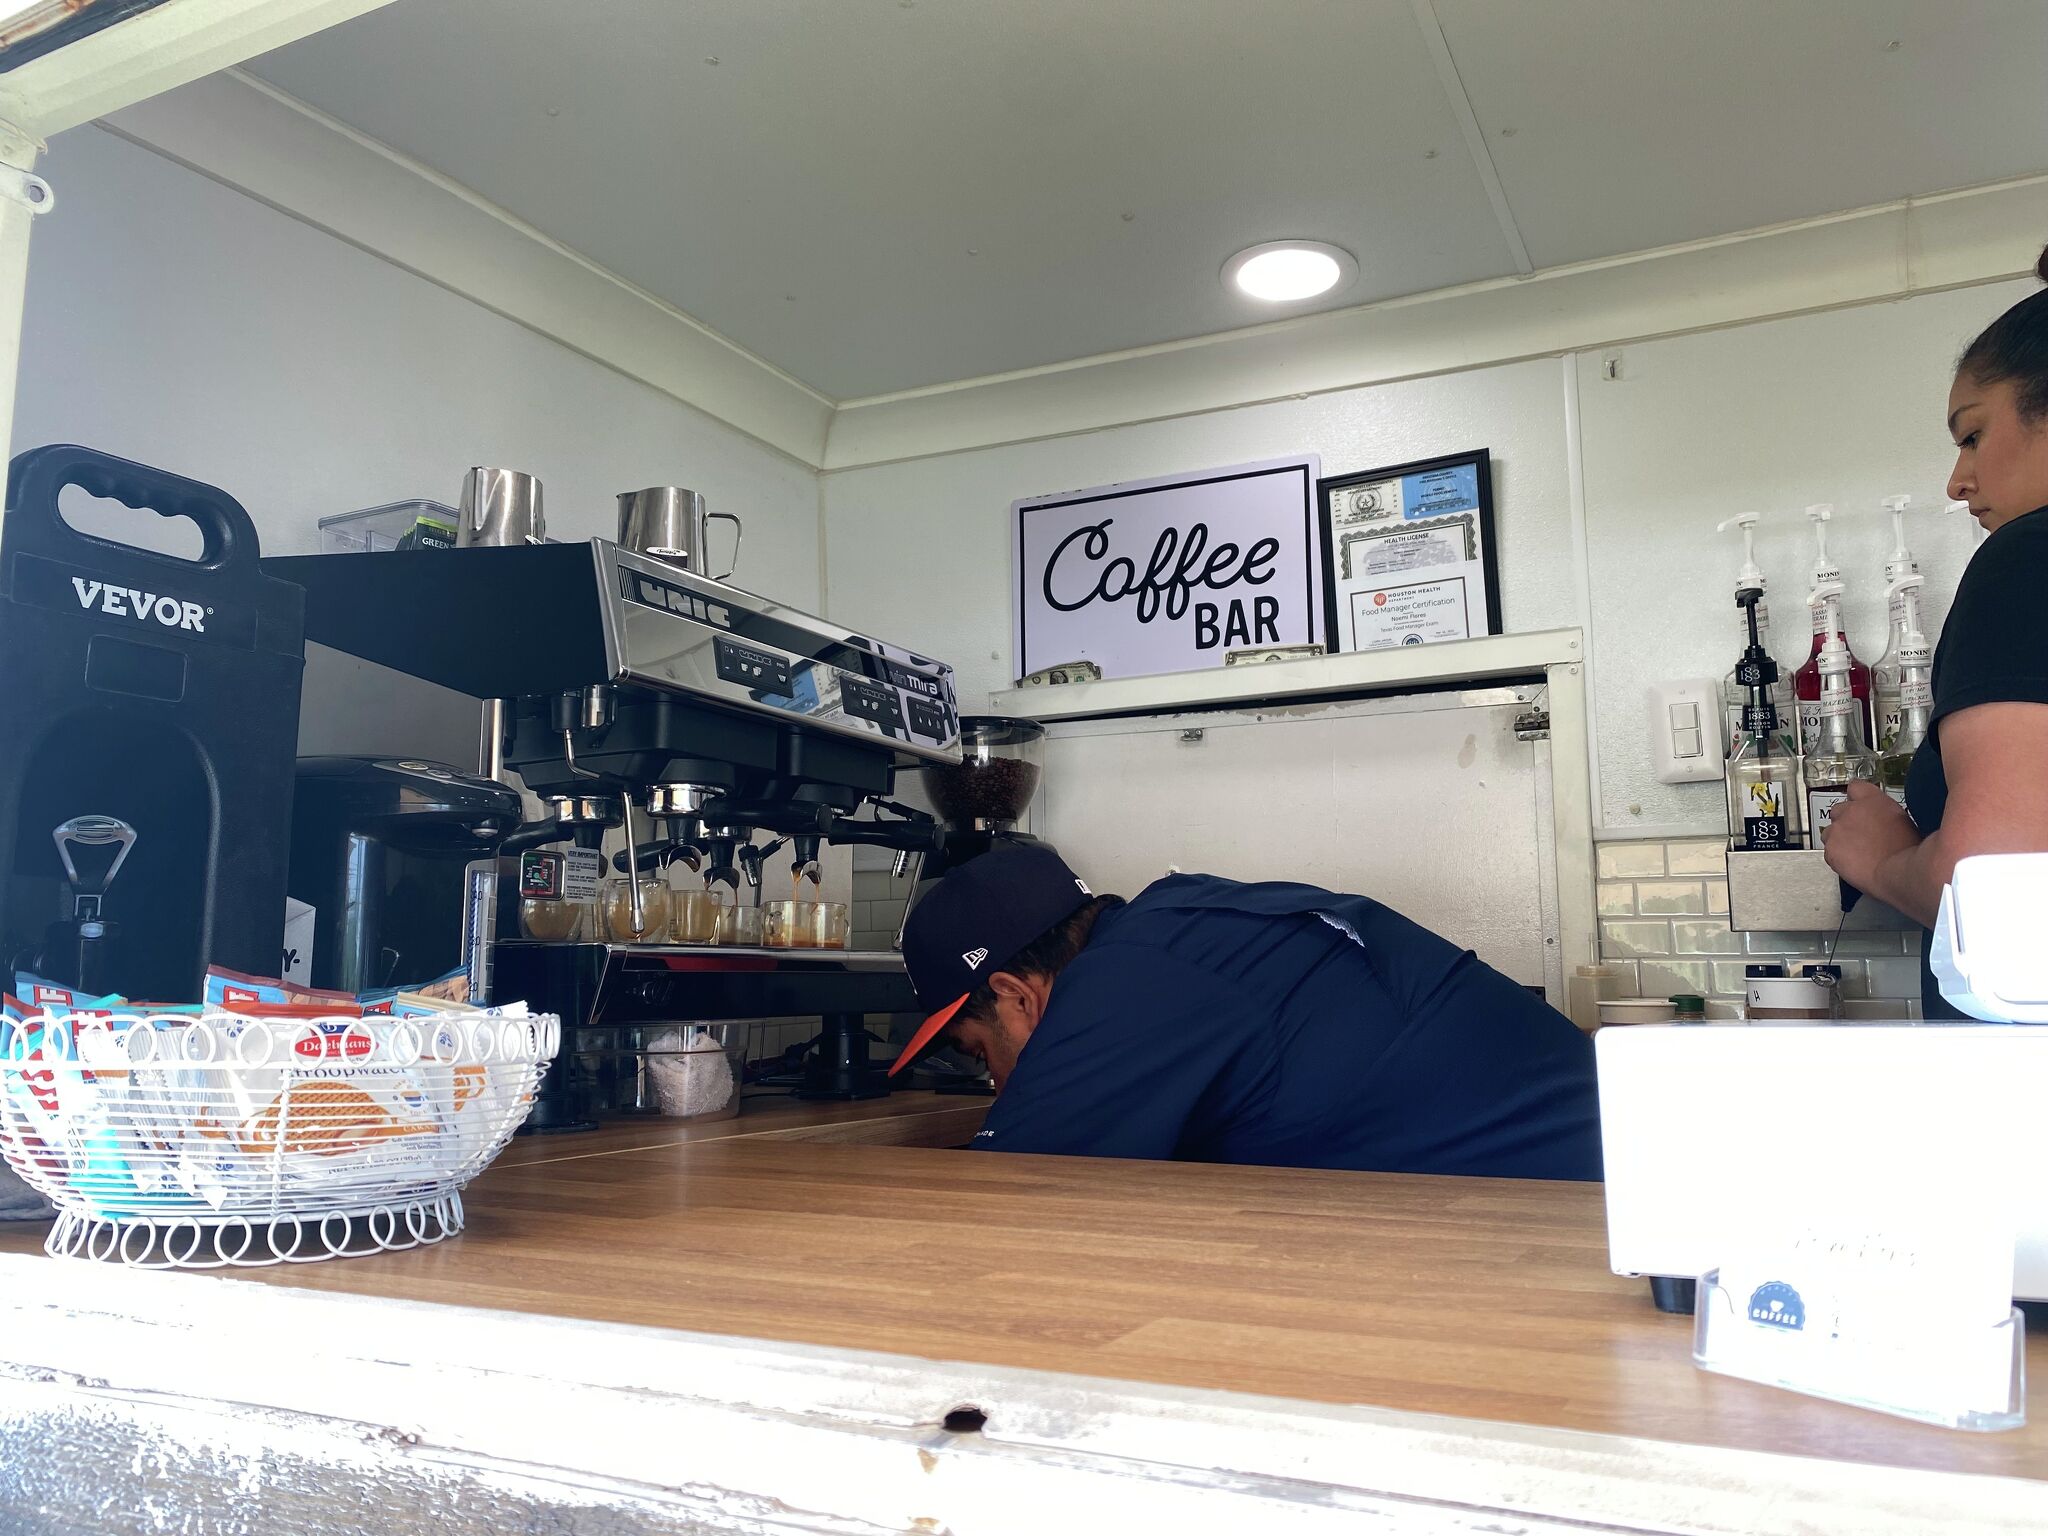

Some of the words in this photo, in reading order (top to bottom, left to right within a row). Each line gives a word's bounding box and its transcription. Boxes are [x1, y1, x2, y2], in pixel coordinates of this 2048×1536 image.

[422, 537, 450, 549] GREEN
[1384, 535, 1406, 544] HEALTH
[1406, 532, 1430, 541] LICENSE
[1043, 518, 1280, 624] Coffee
[1388, 590, 1417, 598] HOUSTON
[1419, 586, 1441, 594] HEALTH
[72, 577, 204, 632] VEVOR
[640, 580, 731, 628] UNIC
[1362, 607, 1379, 617] Food
[1380, 604, 1411, 614] Manager
[1412, 597, 1456, 609] Certification
[1195, 595, 1280, 650] BAR
[1900, 649, 1929, 657] MONIN
[1748, 711, 1771, 721] 1883
[1752, 1308, 1797, 1325] COFFEE
